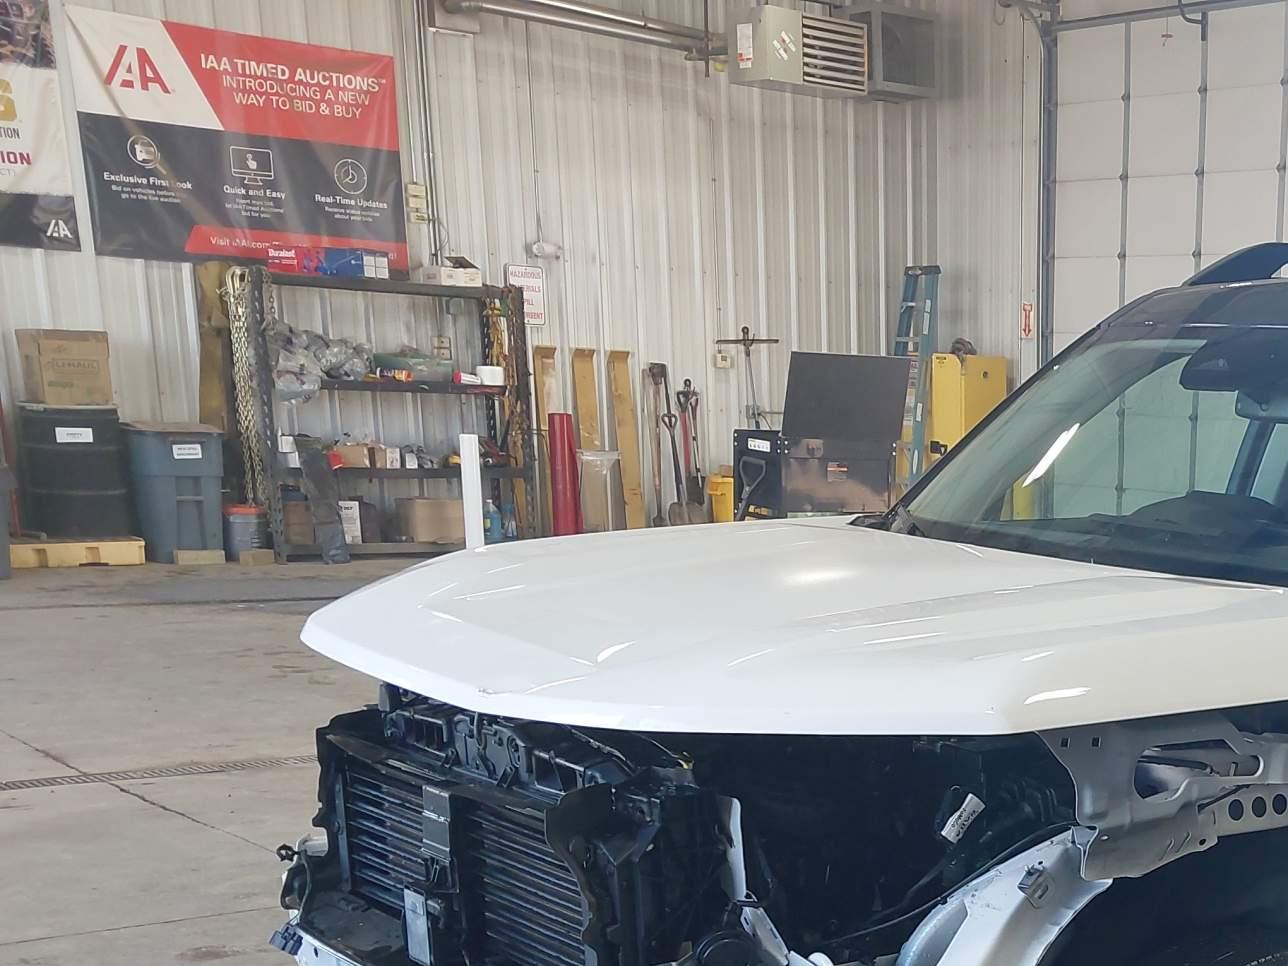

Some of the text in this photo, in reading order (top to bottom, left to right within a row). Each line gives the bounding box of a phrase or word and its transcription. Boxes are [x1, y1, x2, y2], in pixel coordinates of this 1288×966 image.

[200, 53, 231, 73] IAA
[234, 59, 289, 80] TIMED
[223, 75, 370, 106] INTRODUCING A NEW
[233, 92, 362, 120] WAY TO BID & BUY
[103, 171, 148, 185] Exclusive
[149, 176, 169, 187] First
[223, 184, 287, 200] Quick and Easy
[314, 193, 388, 209] Real-Time Updates
[210, 236, 230, 247] Visit
[268, 248, 296, 258] Duralast
